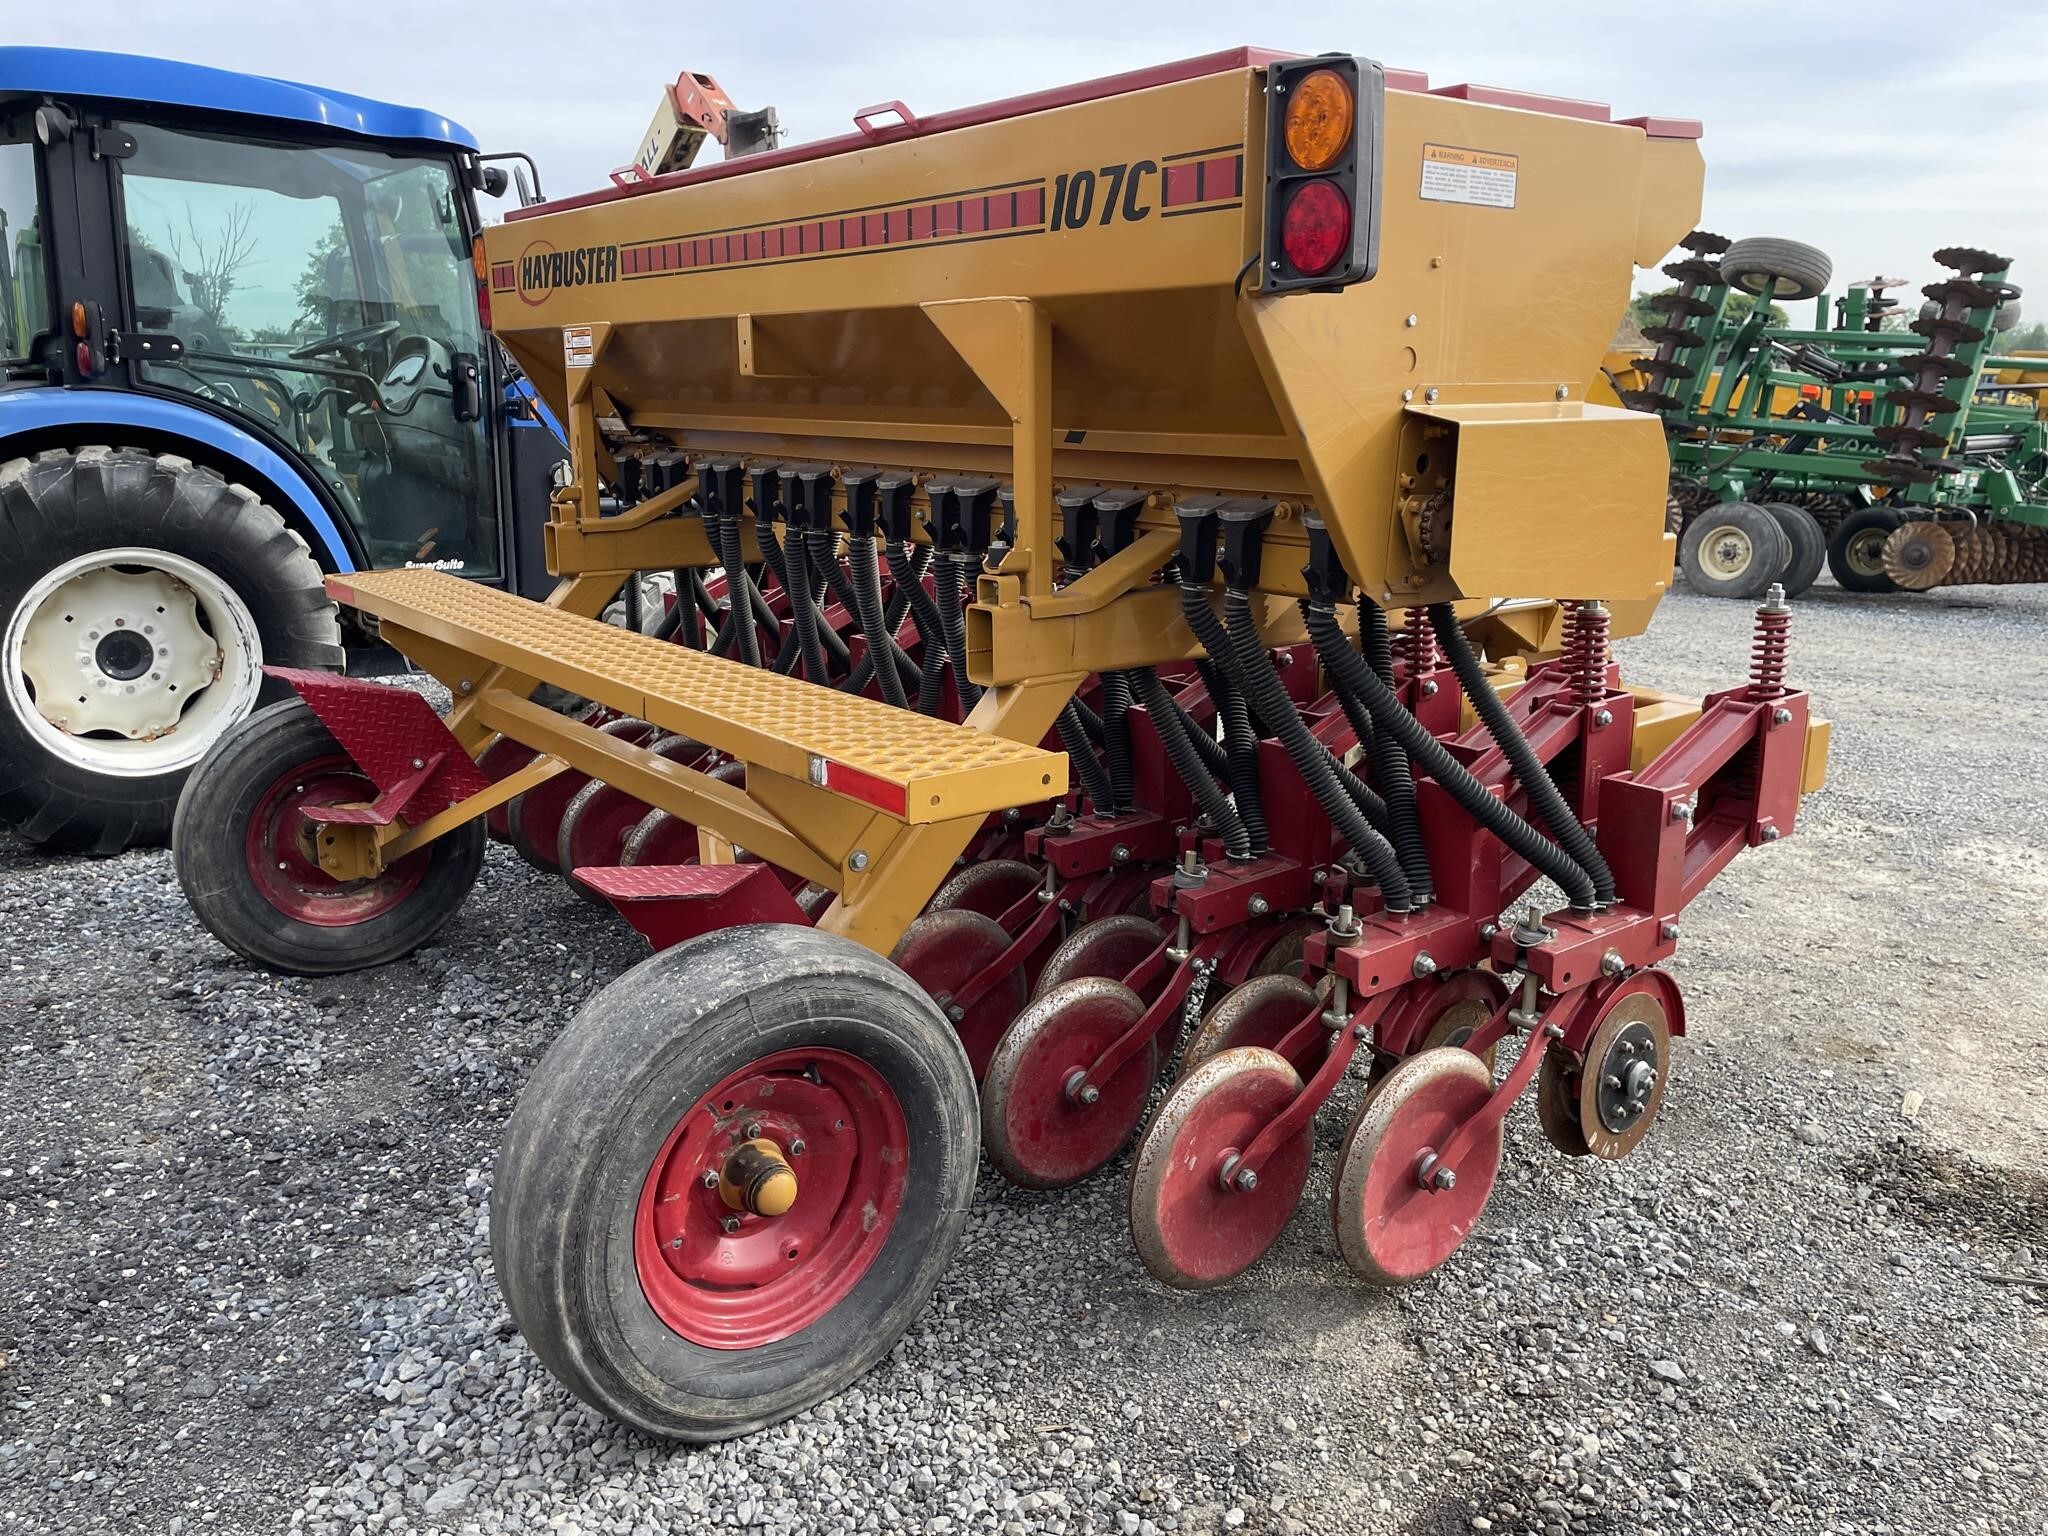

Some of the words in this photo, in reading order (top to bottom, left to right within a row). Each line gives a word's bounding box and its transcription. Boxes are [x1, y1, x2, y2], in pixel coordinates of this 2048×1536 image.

[1438, 150, 1465, 162] WARNING
[1050, 160, 1158, 232] 107C
[522, 245, 618, 290] HAYBUSTER
